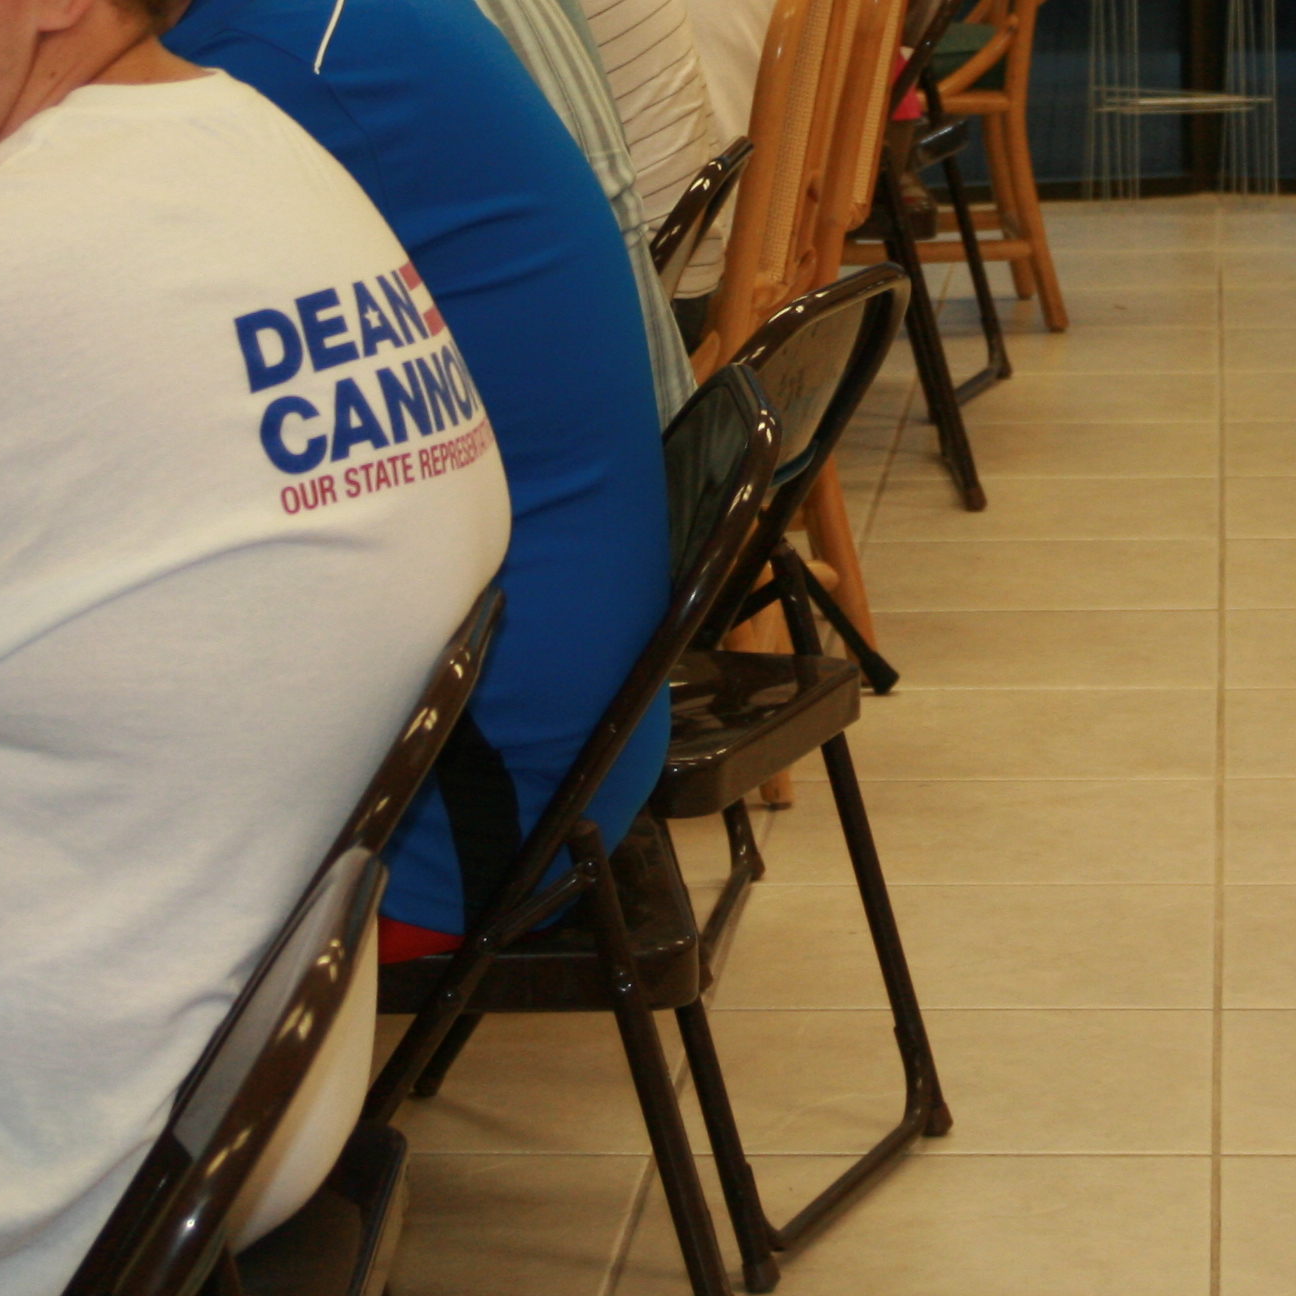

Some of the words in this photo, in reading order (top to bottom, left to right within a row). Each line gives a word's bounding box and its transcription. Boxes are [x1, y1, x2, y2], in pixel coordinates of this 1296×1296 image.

[233, 269, 430, 394] DEAN
[280, 473, 337, 516] OUR
[344, 452, 415, 498] STATE
